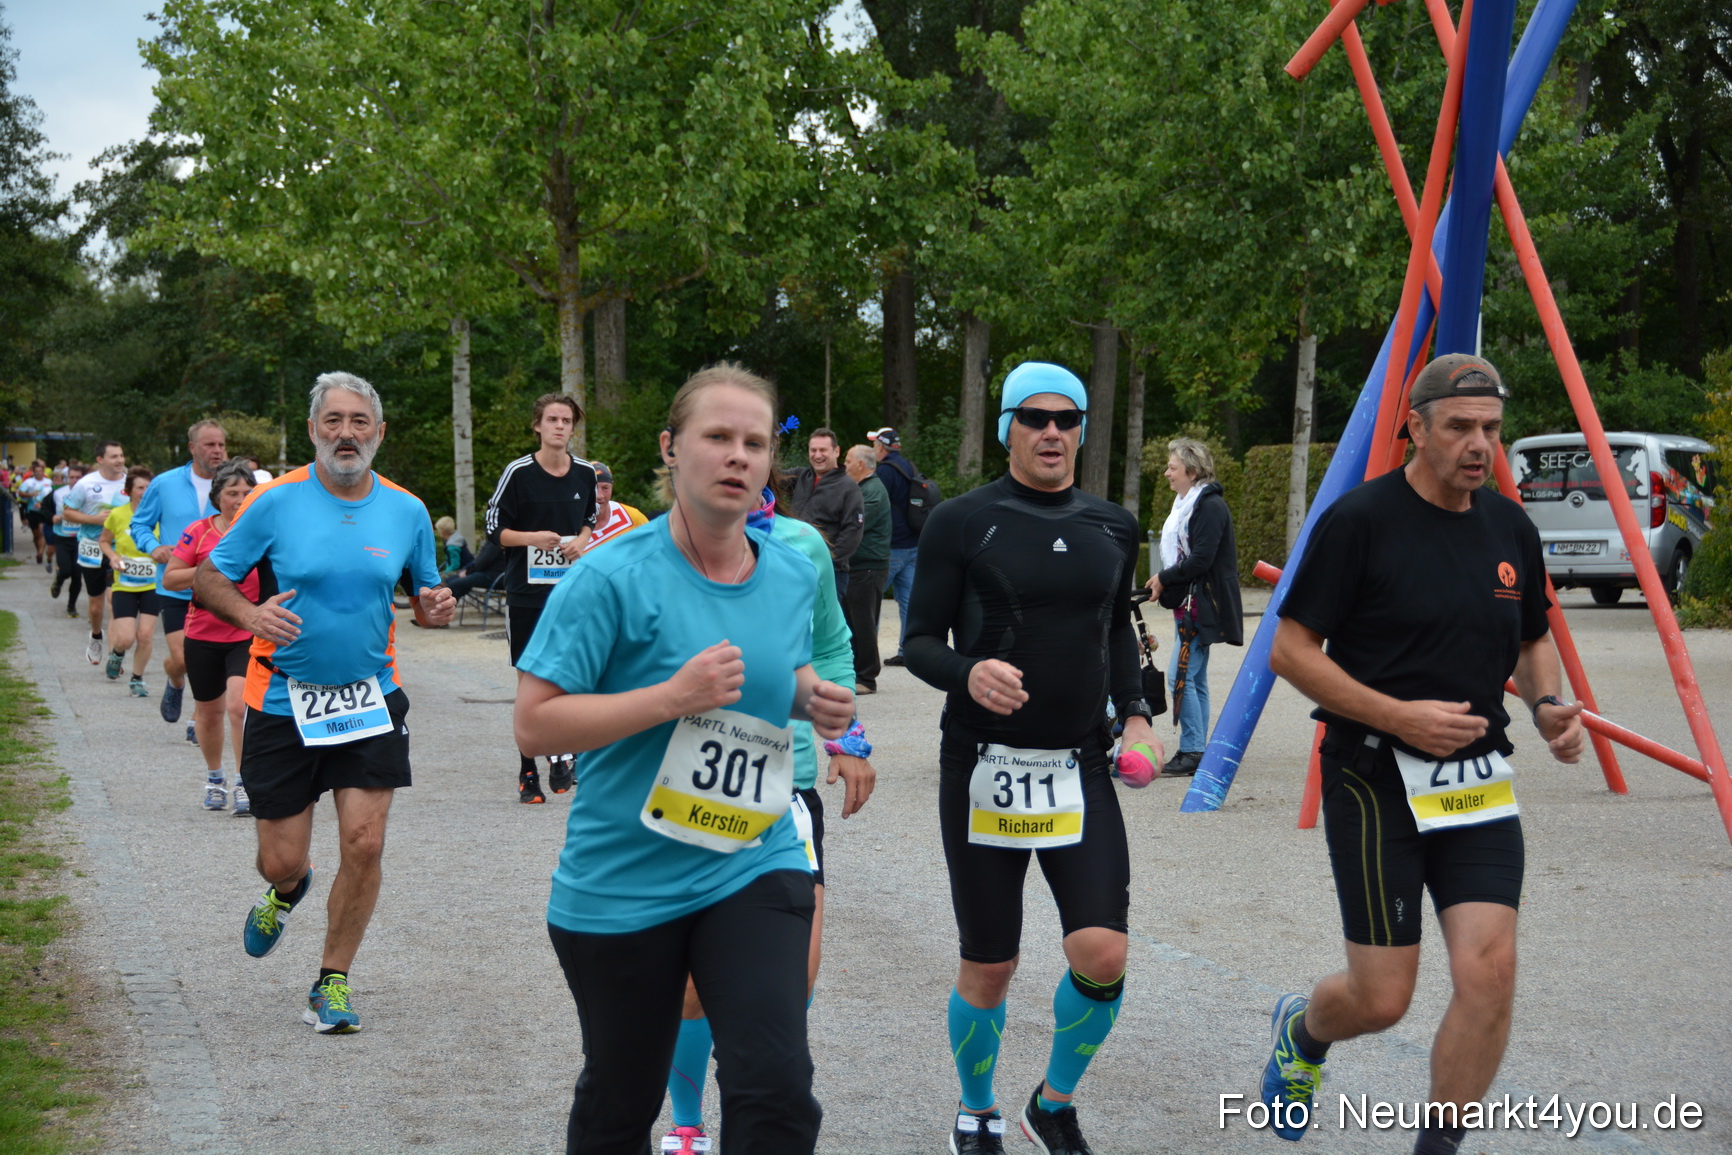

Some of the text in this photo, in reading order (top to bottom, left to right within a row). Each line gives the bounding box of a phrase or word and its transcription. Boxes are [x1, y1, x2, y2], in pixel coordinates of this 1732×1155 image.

[1539, 453, 1605, 469] SEE-CA
[1586, 543, 1597, 551] 22
[534, 548, 572, 566] 253
[123, 562, 153, 576] 2325
[301, 681, 377, 720] 2292
[326, 717, 365, 735] Martin
[683, 714, 787, 753] PARTL Neumarkt
[980, 755, 1062, 768] PARTL Neumarkt
[662, 776, 670, 786] D
[691, 740, 769, 804] 301
[993, 770, 1057, 809] 311
[1440, 793, 1485, 812] Walter
[687, 803, 749, 835] Kerstin
[998, 817, 1054, 834] Richard
